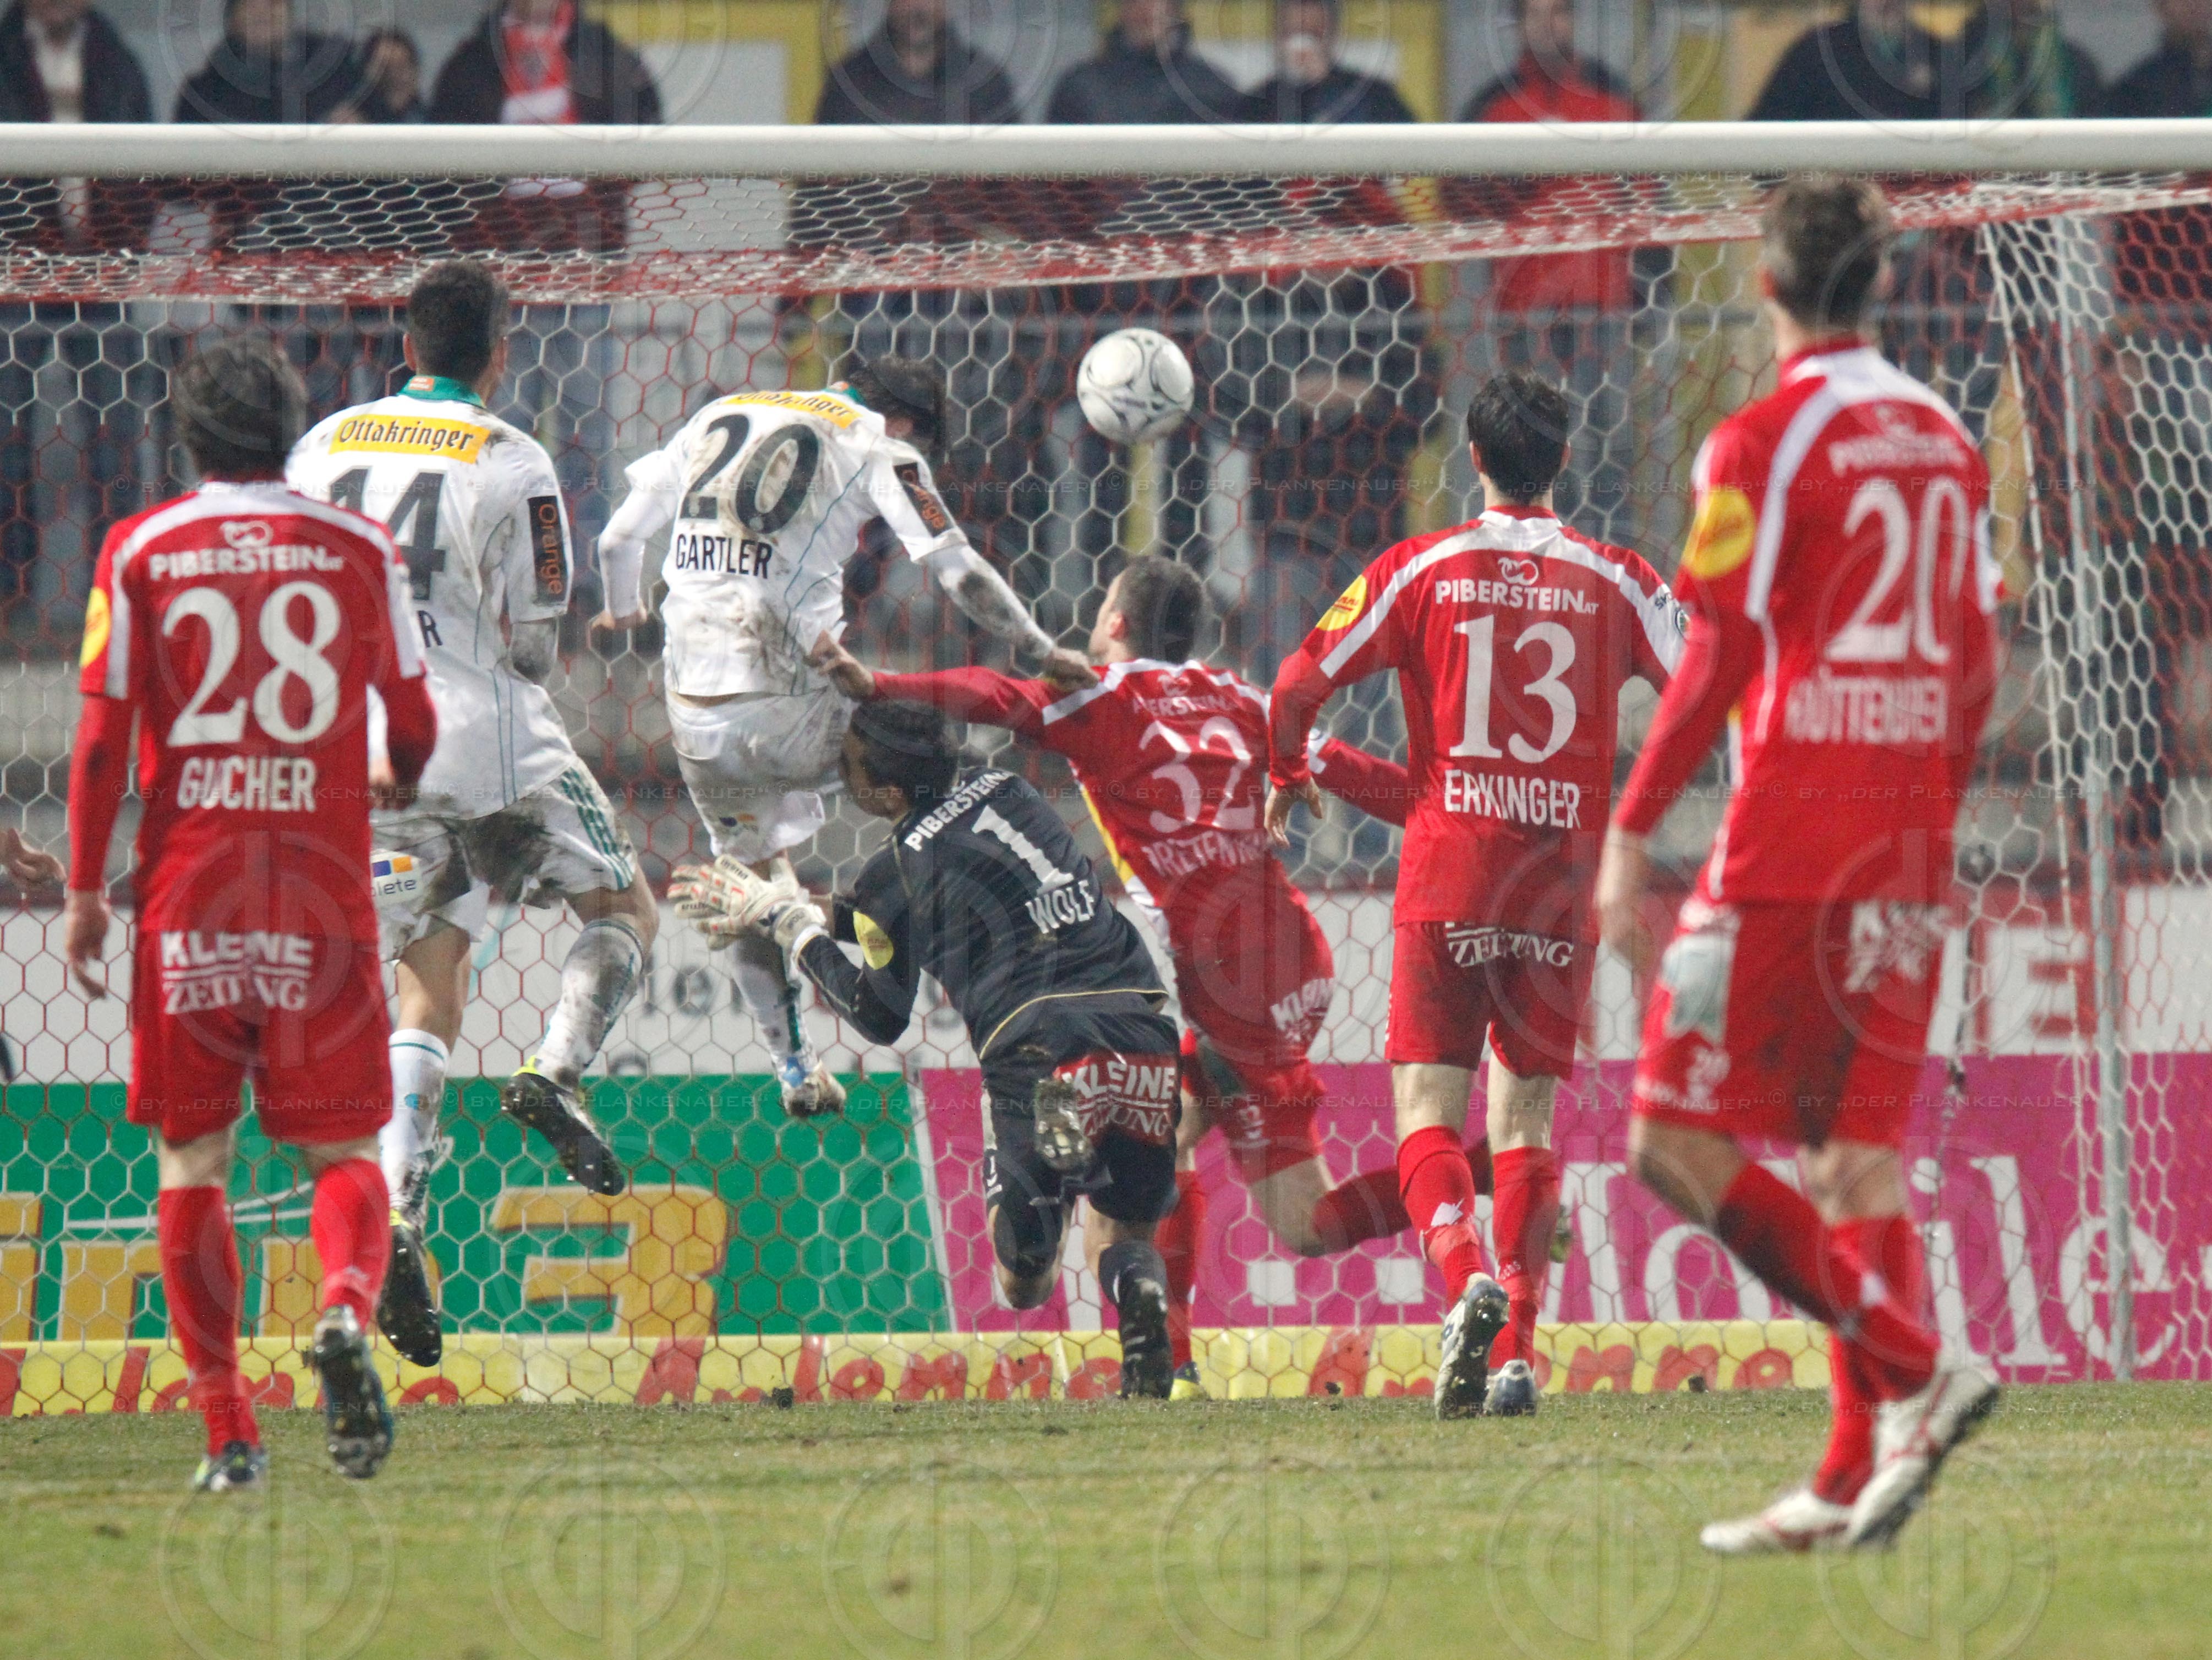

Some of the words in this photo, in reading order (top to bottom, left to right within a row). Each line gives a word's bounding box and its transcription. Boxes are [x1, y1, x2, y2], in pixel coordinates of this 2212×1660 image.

[340, 419, 473, 451] Ottakringer
[680, 413, 819, 534] 20
[538, 502, 563, 596] Orange
[676, 533, 773, 579] GARTLER
[1826, 474, 1970, 662] 20
[162, 581, 340, 747] 28
[1449, 614, 1577, 764] 13
[177, 755, 317, 813] GUCHER
[1138, 715, 1257, 833] 32
[1444, 768, 1581, 830] ERKINGER
[971, 805, 1074, 895] 1
[1025, 880, 1094, 934] WOLF
